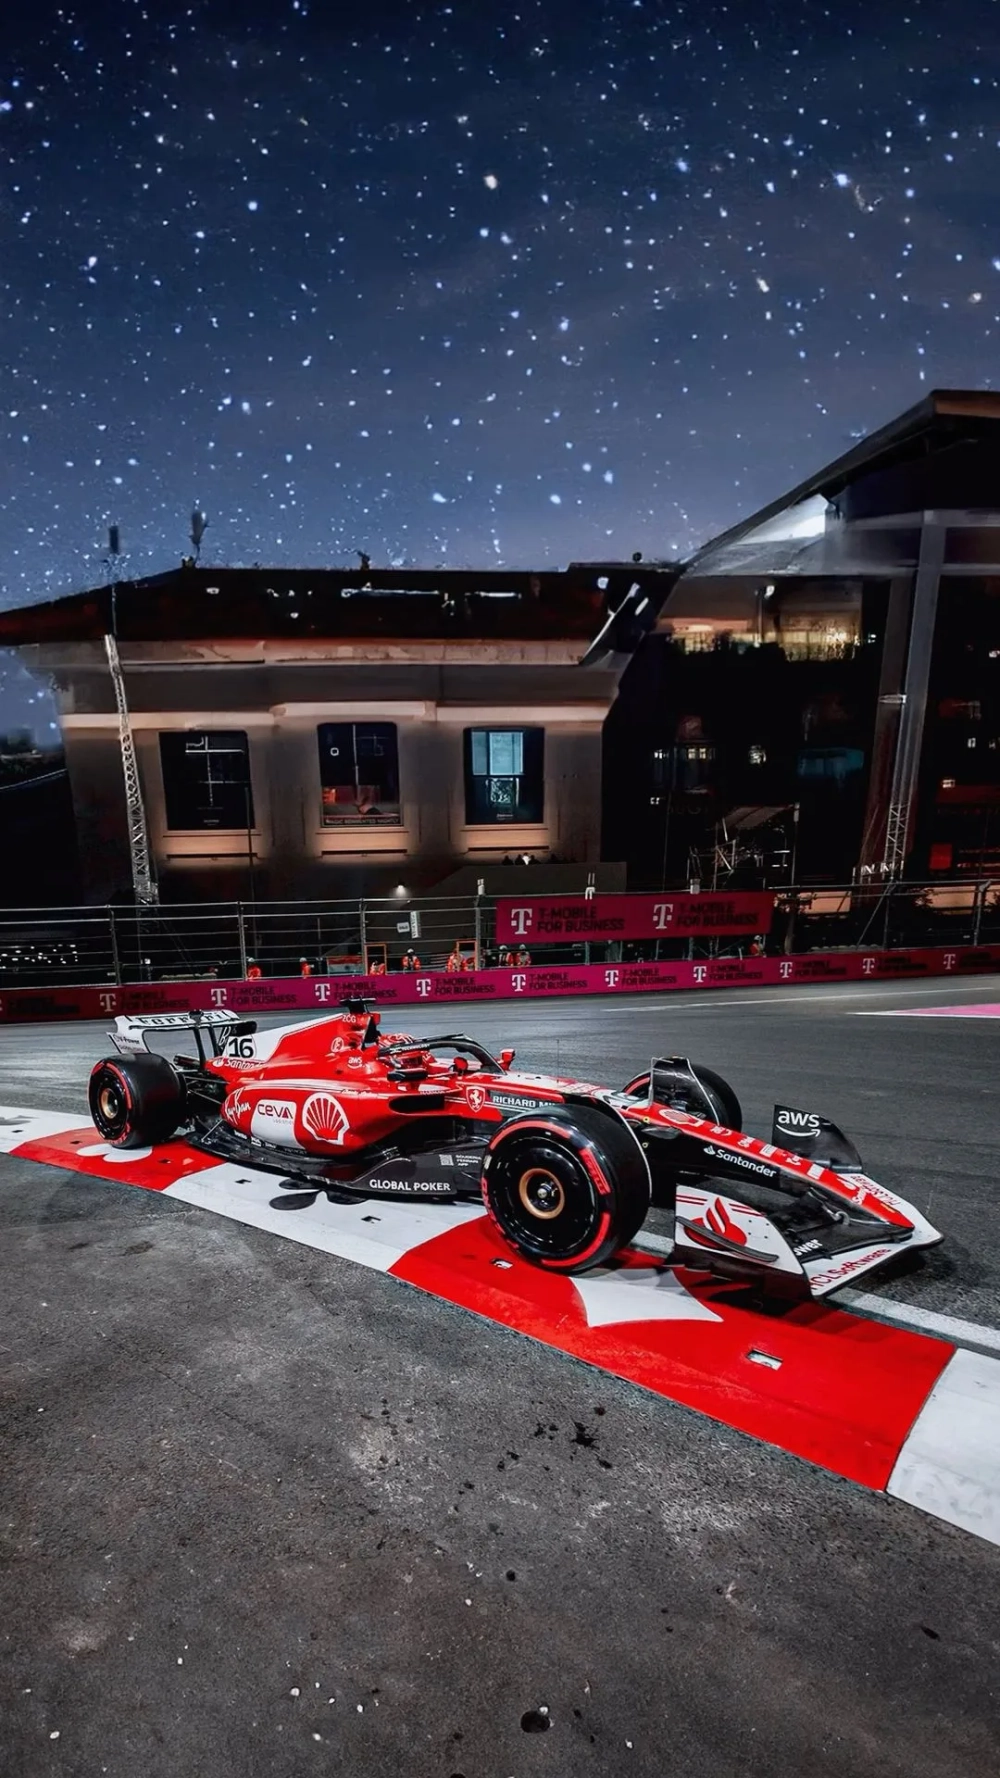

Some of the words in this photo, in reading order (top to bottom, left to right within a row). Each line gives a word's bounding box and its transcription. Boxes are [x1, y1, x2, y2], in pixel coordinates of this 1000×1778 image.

[538, 906, 597, 919] T-MOBILE
[537, 920, 562, 933] FOR
[565, 918, 625, 932] BUSINESS
[676, 915, 701, 927] FOR
[435, 977, 475, 986] T-MOBILE
[529, 972, 569, 981] T-MOBILE
[435, 986, 452, 995] FOR
[454, 984, 496, 994] BUSINESS
[529, 981, 546, 990] FOR
[547, 979, 588, 989] BUSINESS
[231, 996, 249, 1006] FOR
[138, 1012, 223, 1025] Ferrri
[229, 1038, 254, 1059] 16
[492, 1095, 536, 1108] RICHARD
[777, 1110, 820, 1128] aws
[716, 1149, 777, 1178] Santander
[369, 1179, 412, 1191] GLOBAL
[413, 1182, 452, 1191] POKER
